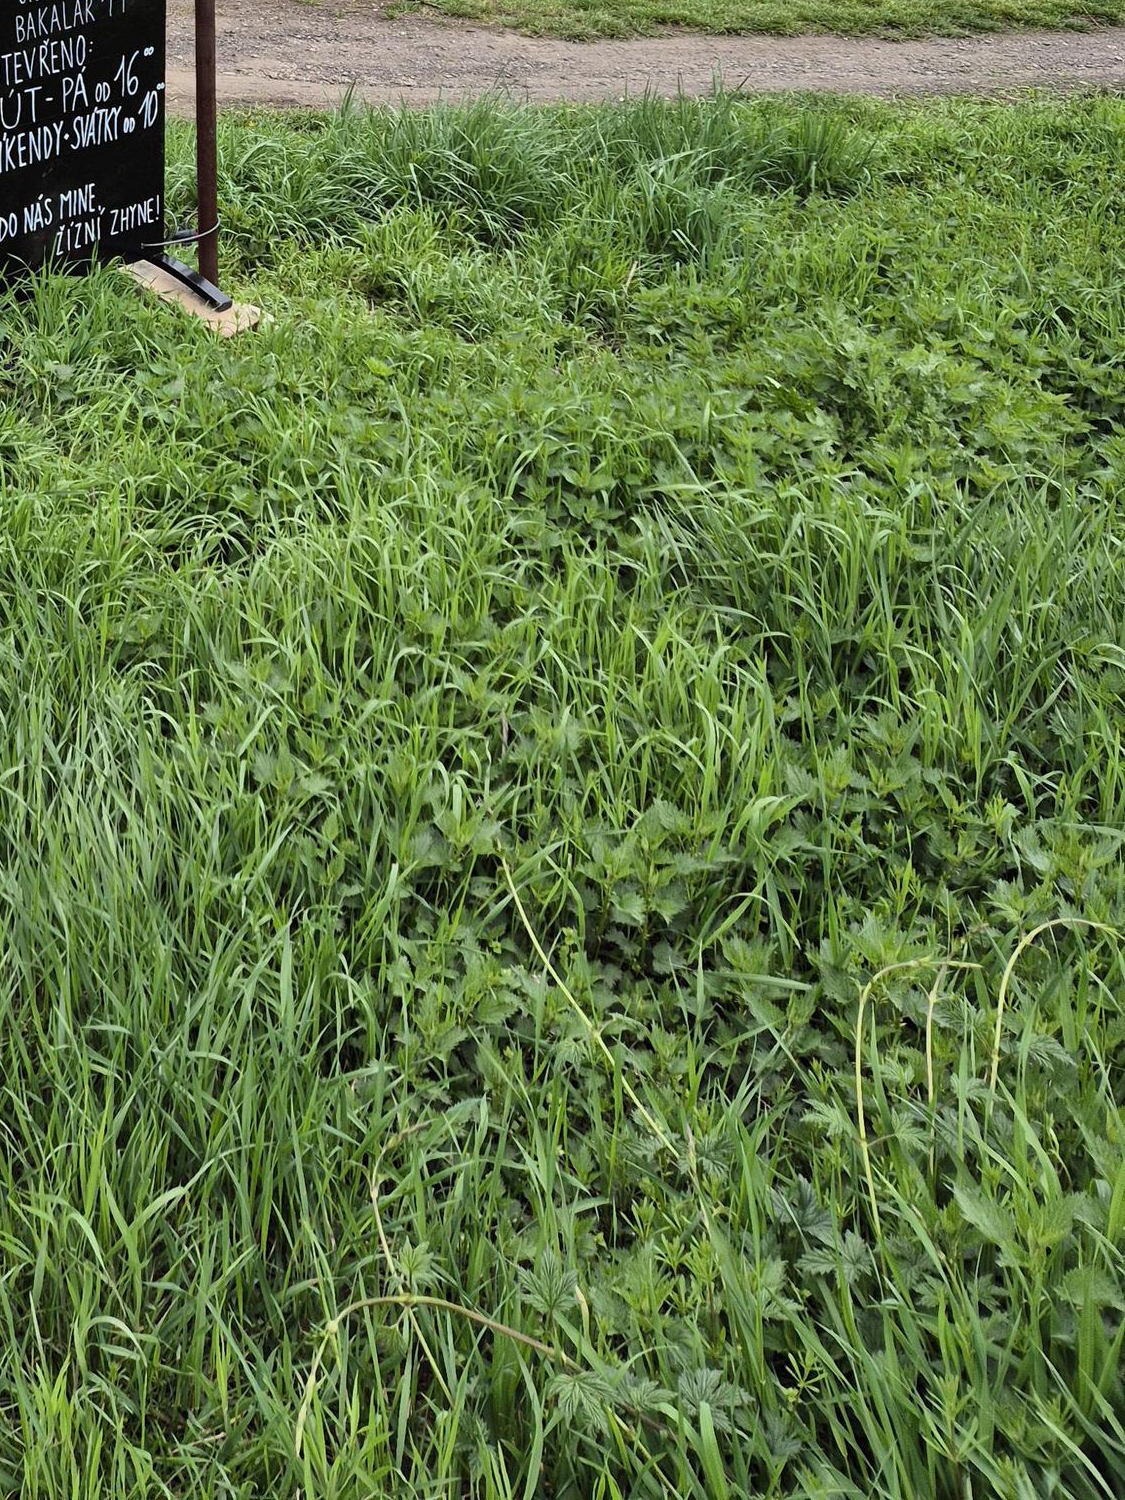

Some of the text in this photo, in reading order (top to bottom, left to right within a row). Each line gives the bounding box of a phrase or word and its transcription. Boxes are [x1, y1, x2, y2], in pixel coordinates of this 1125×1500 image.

[23, 194, 53, 234] NÁS
[55, 194, 160, 256] ŽÍZNÍ ZHYNE!
